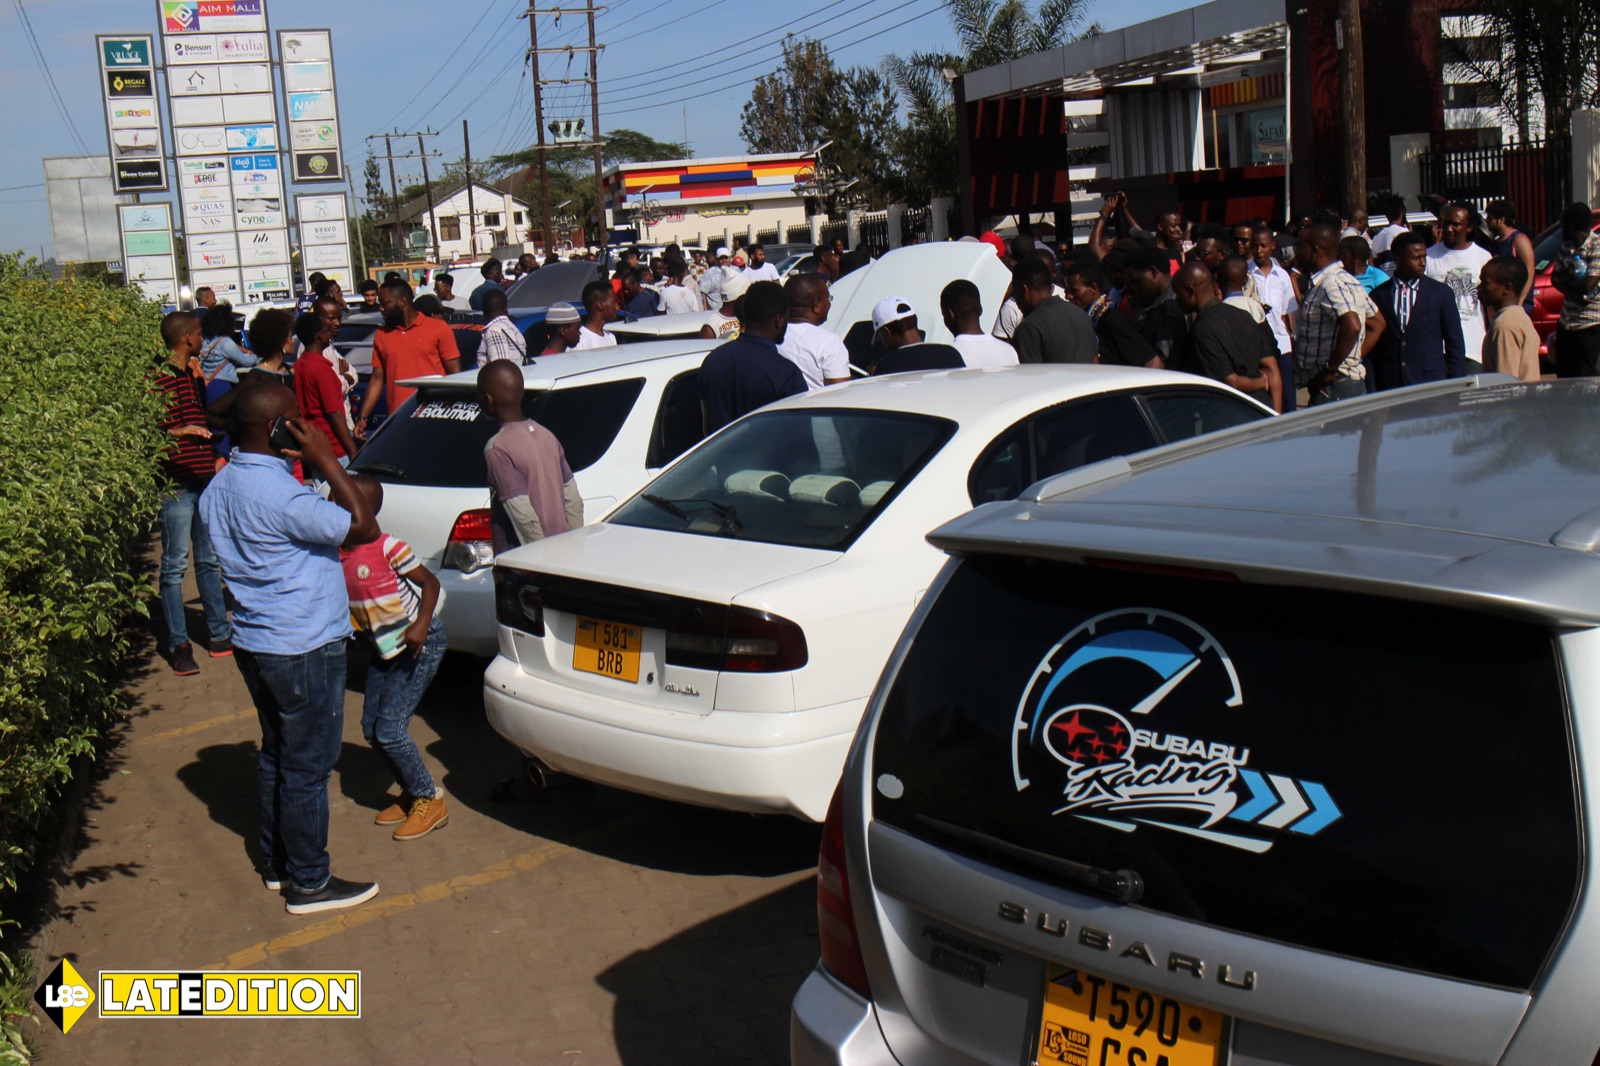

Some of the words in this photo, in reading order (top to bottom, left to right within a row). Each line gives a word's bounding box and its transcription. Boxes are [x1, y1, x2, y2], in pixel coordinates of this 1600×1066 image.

[199, 5, 222, 13] AIM
[226, 4, 260, 12] MALL
[235, 38, 263, 51] tulia
[110, 51, 140, 59] VILLAGE
[1258, 121, 1287, 141] SAFAR
[197, 173, 217, 182] EDGE
[199, 203, 224, 211] QUAS
[201, 218, 221, 226] NAS
[591, 621, 599, 643] T
[603, 624, 628, 650] 581
[597, 649, 623, 675] BRB
[1134, 730, 1250, 767] SUBARU
[1068, 757, 1233, 801] Racing
[998, 901, 1257, 990] SUBARU
[1086, 975, 1181, 1047] T590
[1068, 1030, 1087, 1045] LOSO
[1063, 1052, 1087, 1066] SOUND
